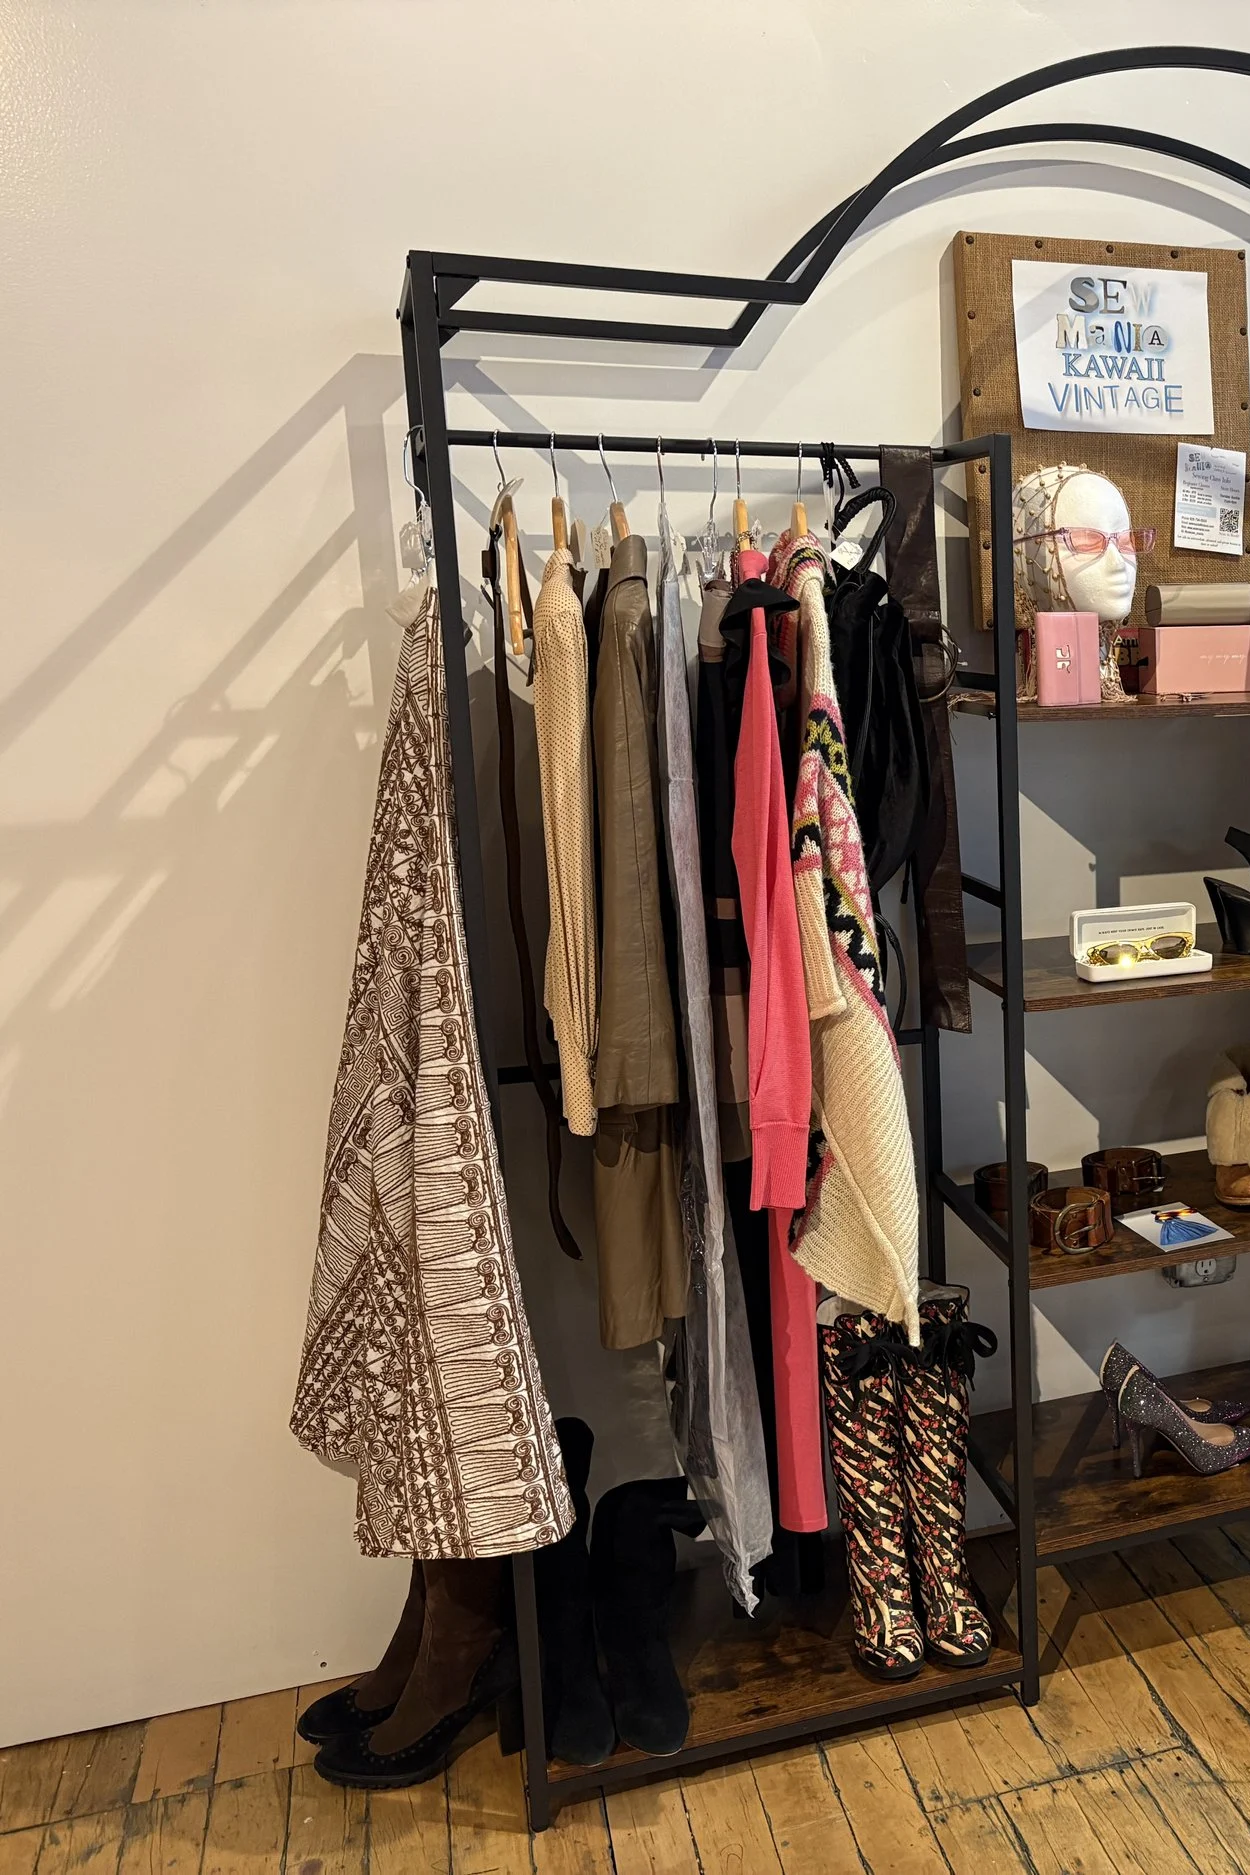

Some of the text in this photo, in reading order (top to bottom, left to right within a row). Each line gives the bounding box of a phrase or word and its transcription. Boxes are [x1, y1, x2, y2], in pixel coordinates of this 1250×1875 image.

[1068, 276, 1153, 316] SEW
[1062, 353, 1165, 381] KAWAII
[1048, 382, 1184, 413] VINTAGE
